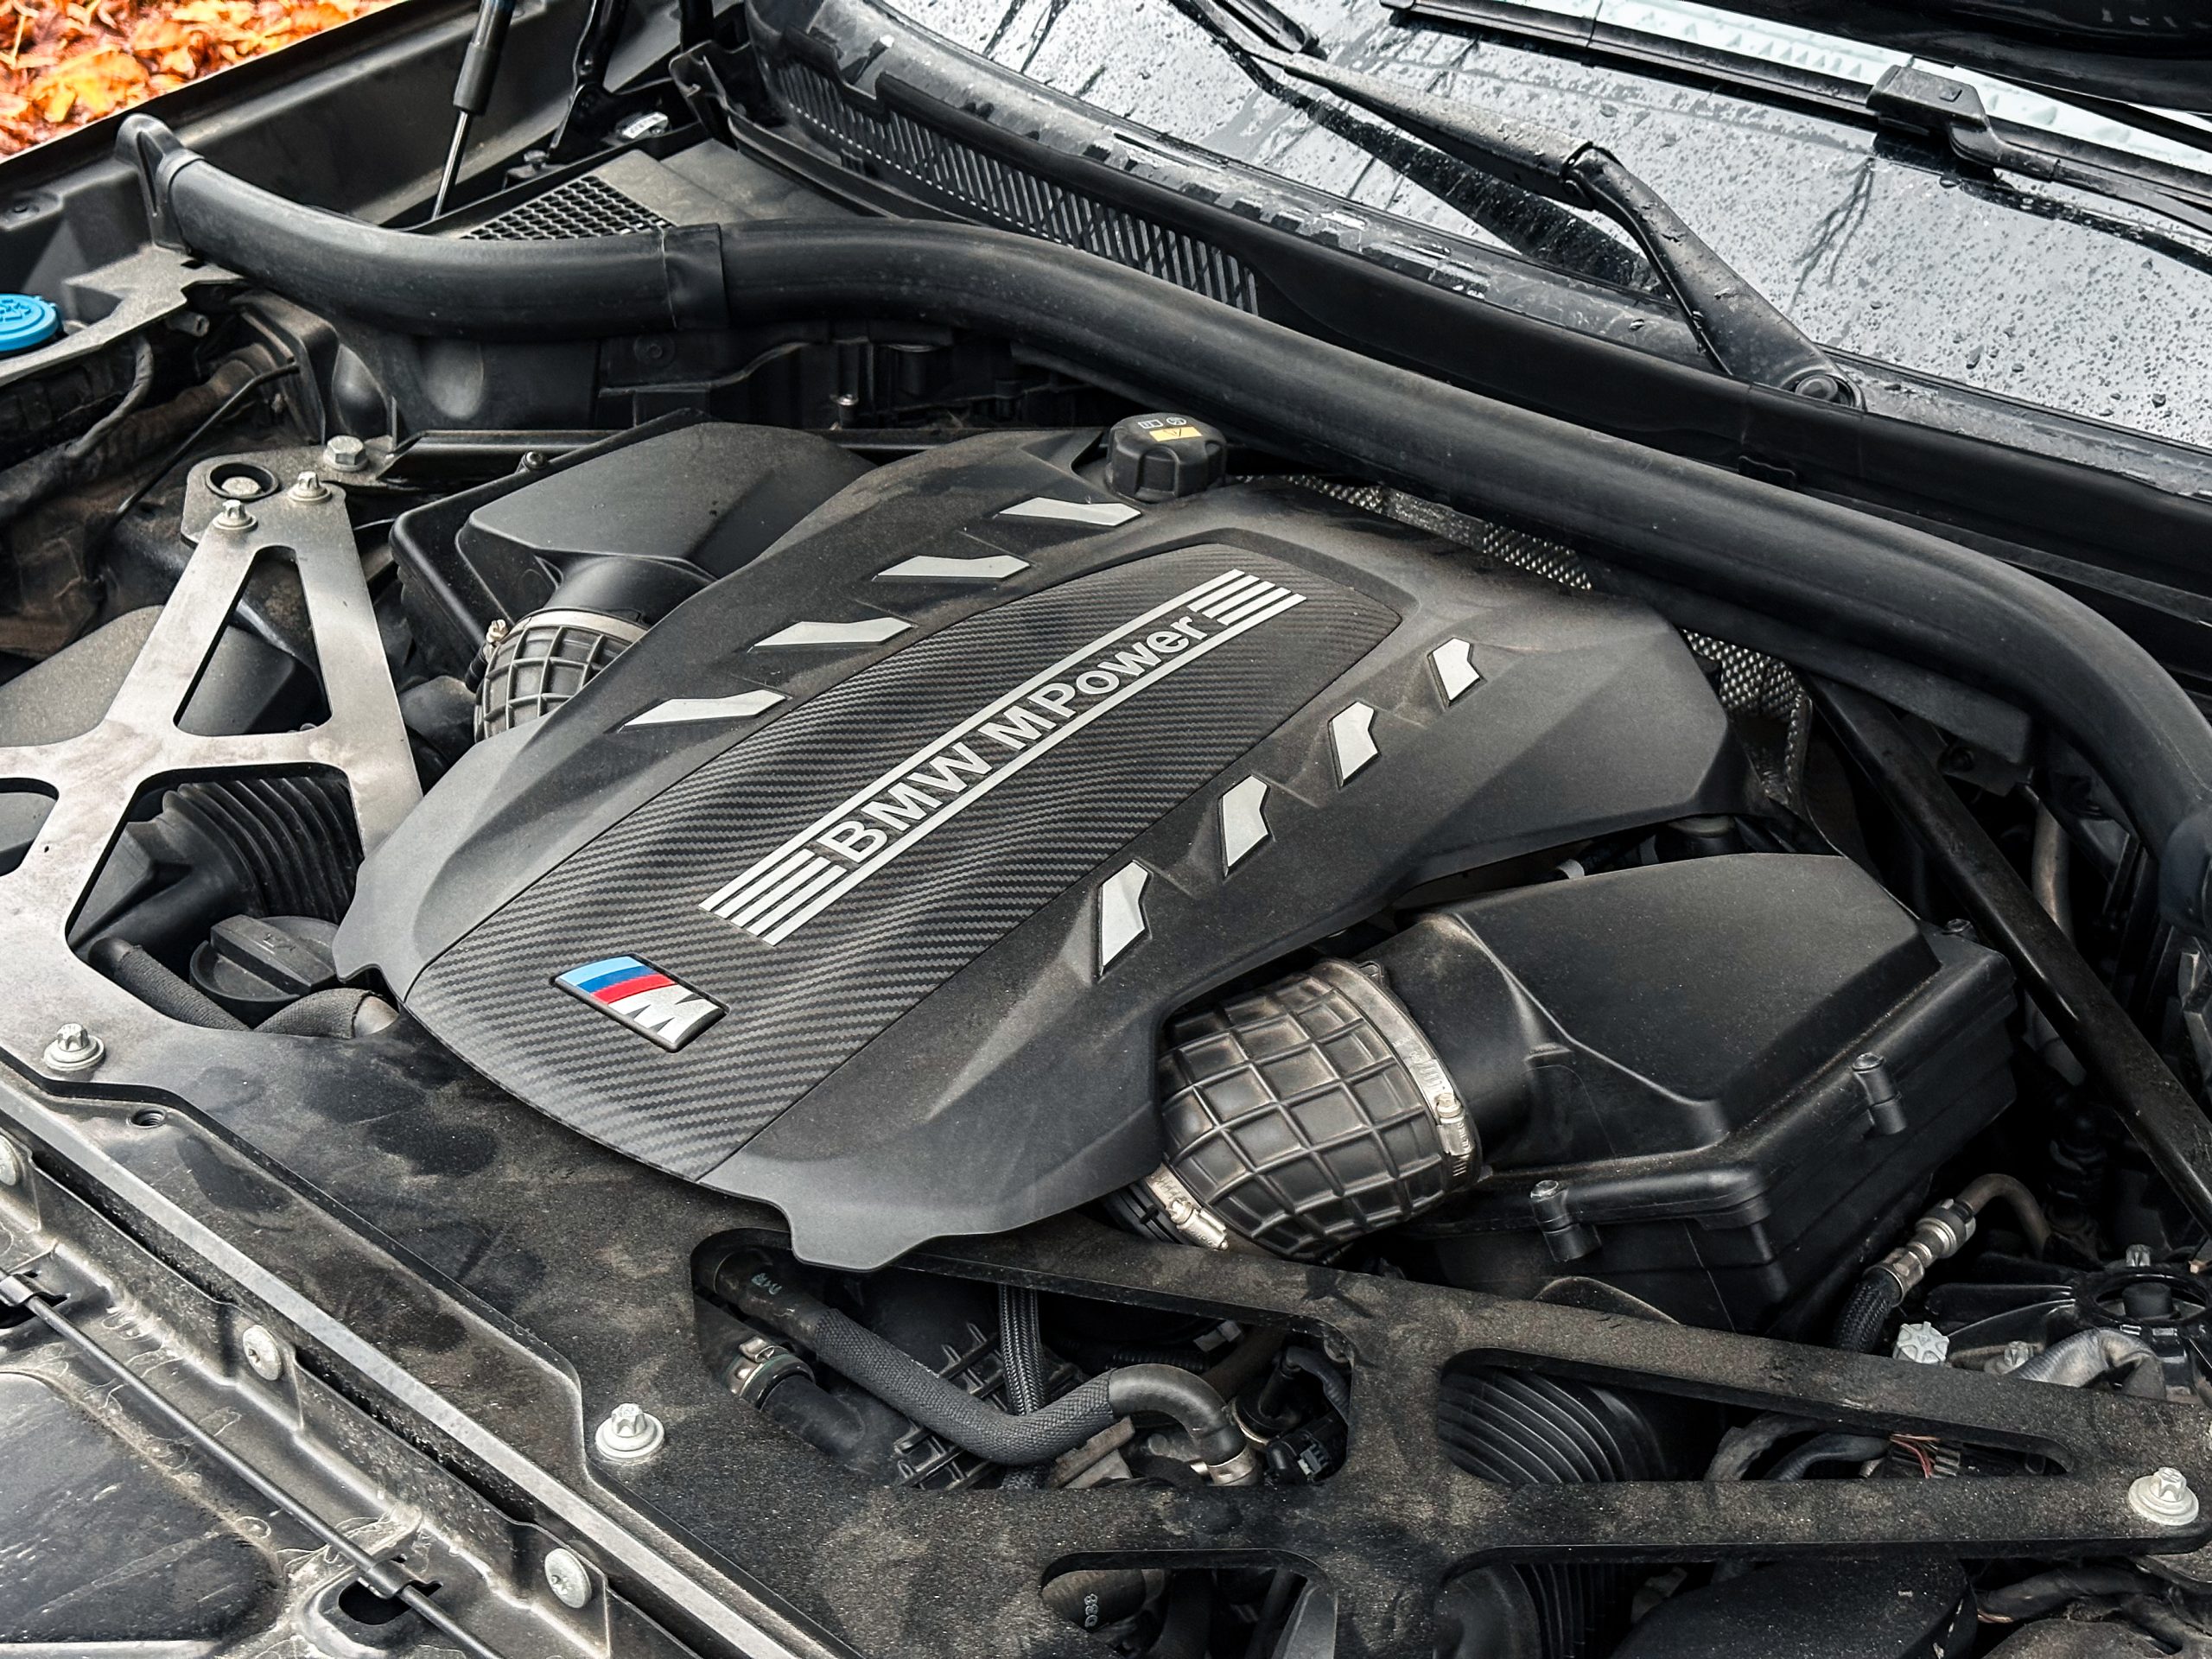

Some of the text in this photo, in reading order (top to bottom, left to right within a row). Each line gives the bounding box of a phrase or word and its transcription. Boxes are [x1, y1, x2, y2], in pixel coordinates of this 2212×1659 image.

[816, 615, 1208, 863] BMW MPower
[607, 983, 720, 1044] M
